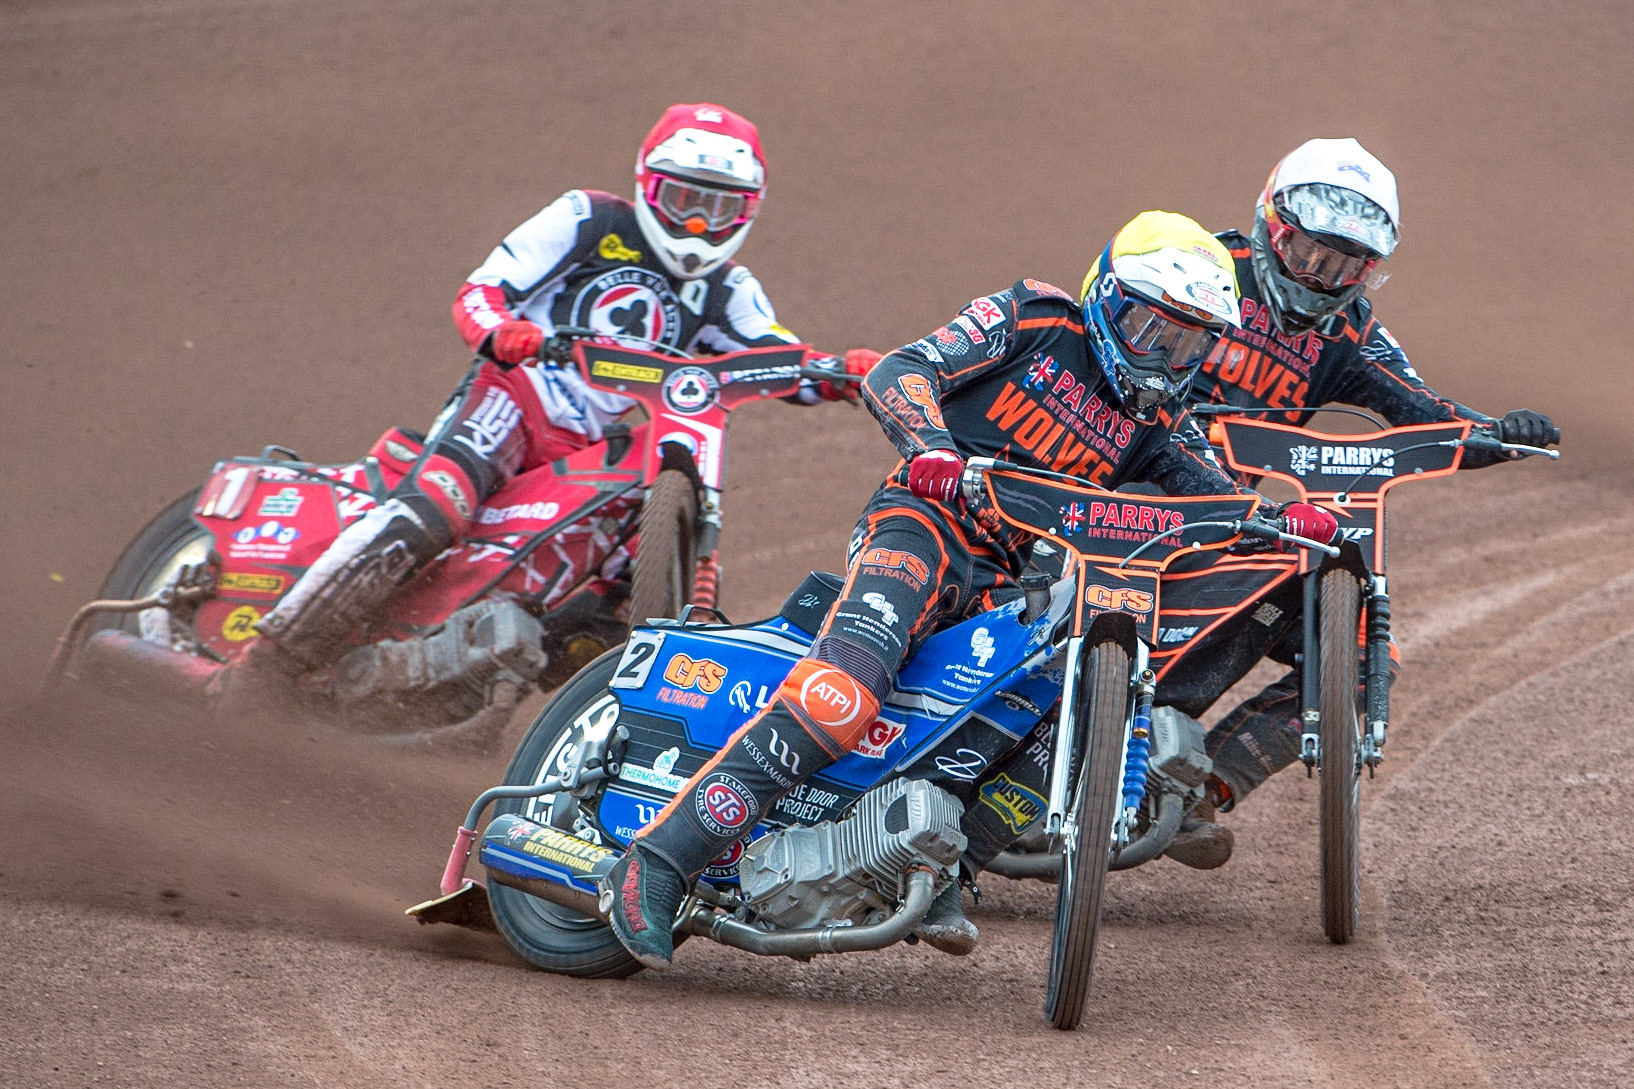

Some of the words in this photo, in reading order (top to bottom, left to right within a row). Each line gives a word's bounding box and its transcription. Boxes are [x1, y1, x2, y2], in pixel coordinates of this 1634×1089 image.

[1052, 369, 1136, 449] PARRYS
[1321, 446, 1395, 467] PARRYS
[214, 468, 251, 516] 1
[479, 502, 560, 524] BETARD
[1089, 501, 1184, 536] PARRYS
[863, 566, 922, 593] FILTRATION
[1085, 584, 1154, 613] CFS
[616, 642, 655, 679] 2
[663, 653, 728, 695] CFS
[656, 686, 710, 710] FILTRATION
[810, 681, 852, 714] ATPI
[622, 766, 681, 789] THERMOHOME
[708, 790, 741, 822] STS
[775, 796, 825, 822] PROJECT
[805, 787, 840, 809] DOOR
[523, 841, 595, 873] INTERNATIONAL
